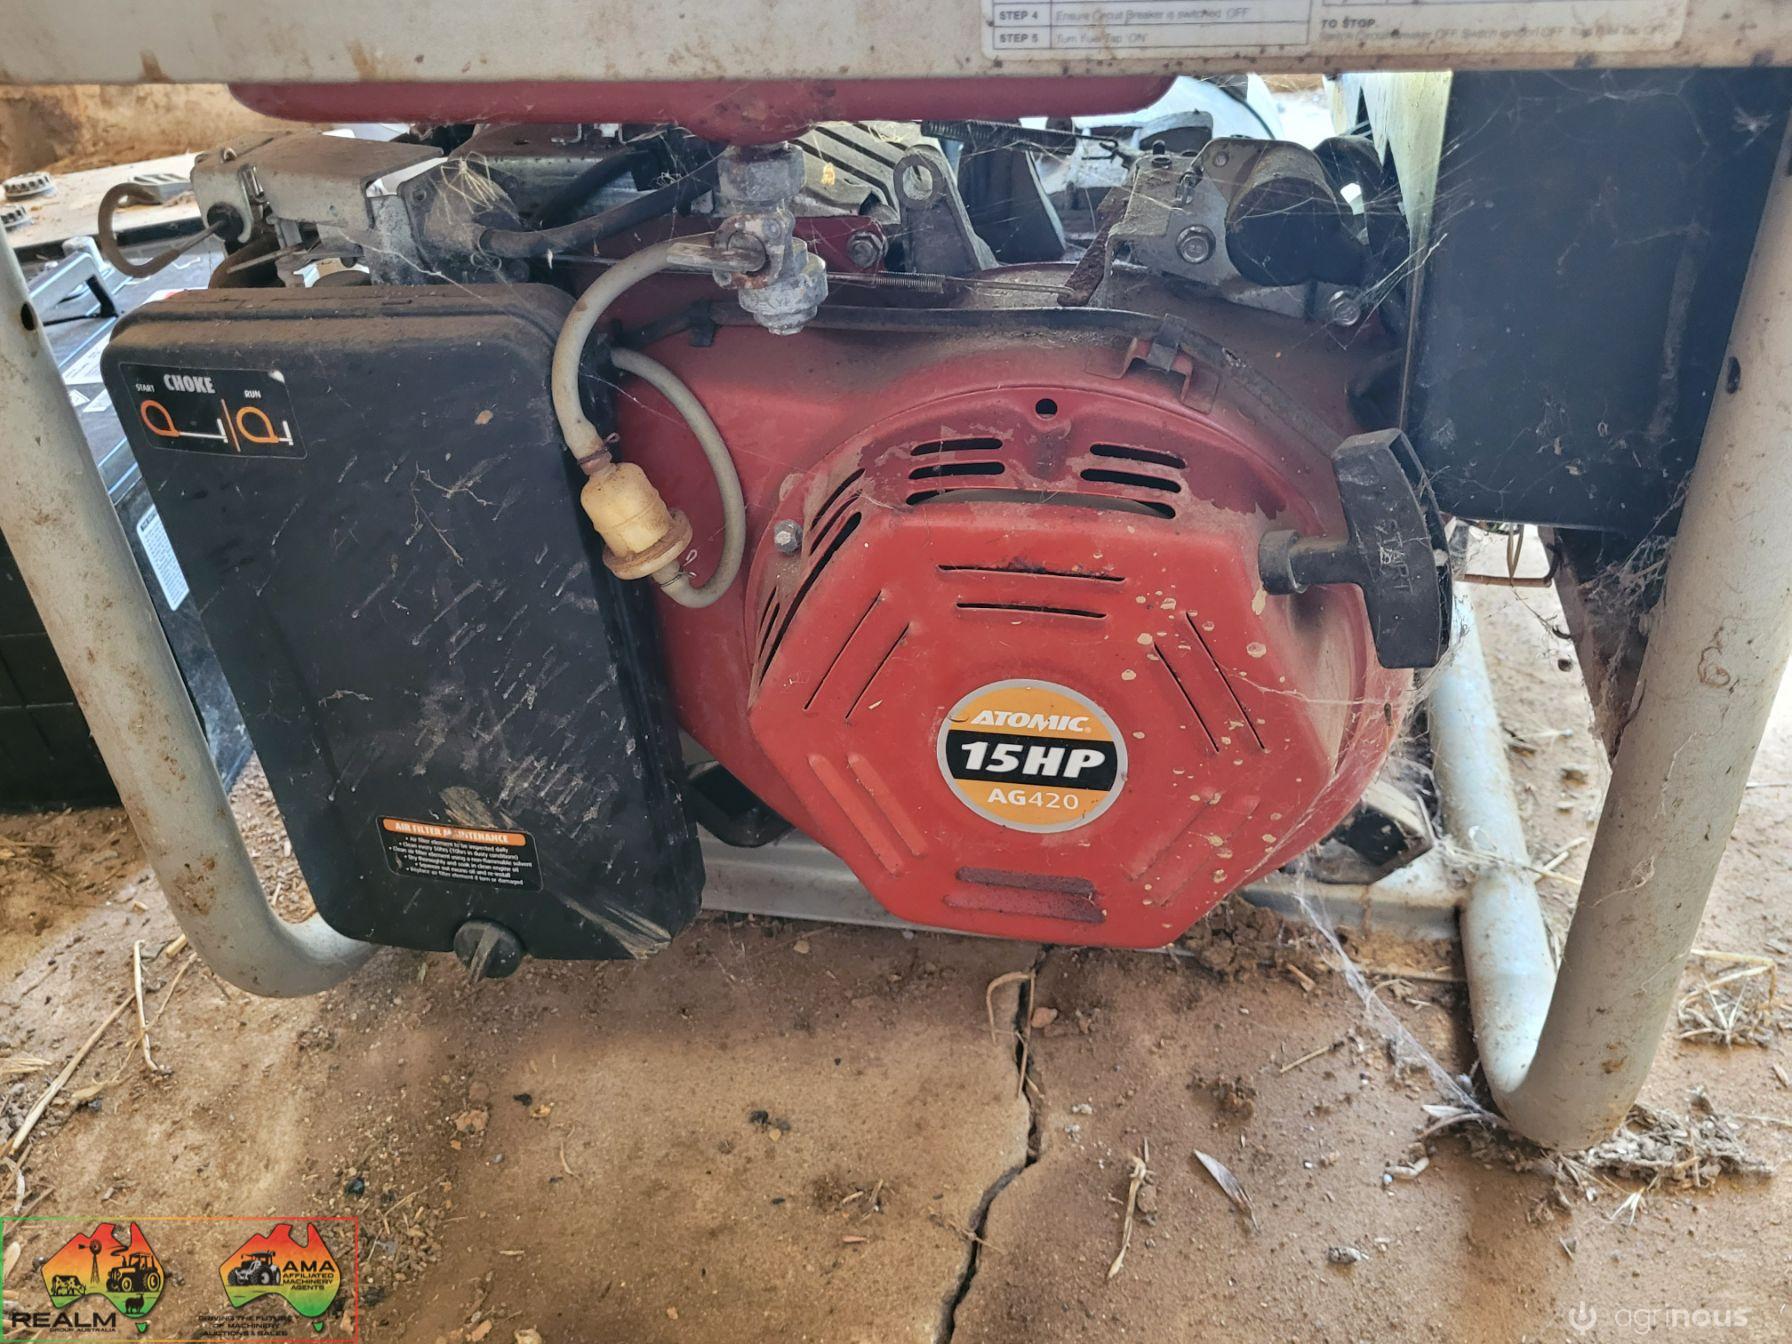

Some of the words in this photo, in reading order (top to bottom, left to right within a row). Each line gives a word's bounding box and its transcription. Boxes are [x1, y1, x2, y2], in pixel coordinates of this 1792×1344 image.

[999, 9, 1029, 21] STEP
[1031, 10, 1039, 21] 4
[1321, 18, 1338, 29] TO
[999, 33, 1029, 43] STEP
[1031, 33, 1039, 43] 5
[135, 383, 156, 393] START
[163, 373, 216, 394] CHOKE
[244, 389, 262, 399] RUN
[970, 709, 1090, 733] ATOMIC
[961, 741, 1106, 779] 15HP
[987, 788, 1079, 810] AG420
[395, 822, 411, 834] AIR
[412, 825, 442, 837] FILTER
[402, 841, 418, 849] Clean
[418, 845, 433, 853] every
[473, 850, 488, 859] dusty
[488, 852, 519, 861] conditions)
[468, 844, 495, 853] inspected
[495, 846, 509, 854] daily
[428, 851, 451, 860] element
[492, 865, 512, 873] engine
[497, 877, 524, 886] damaged
